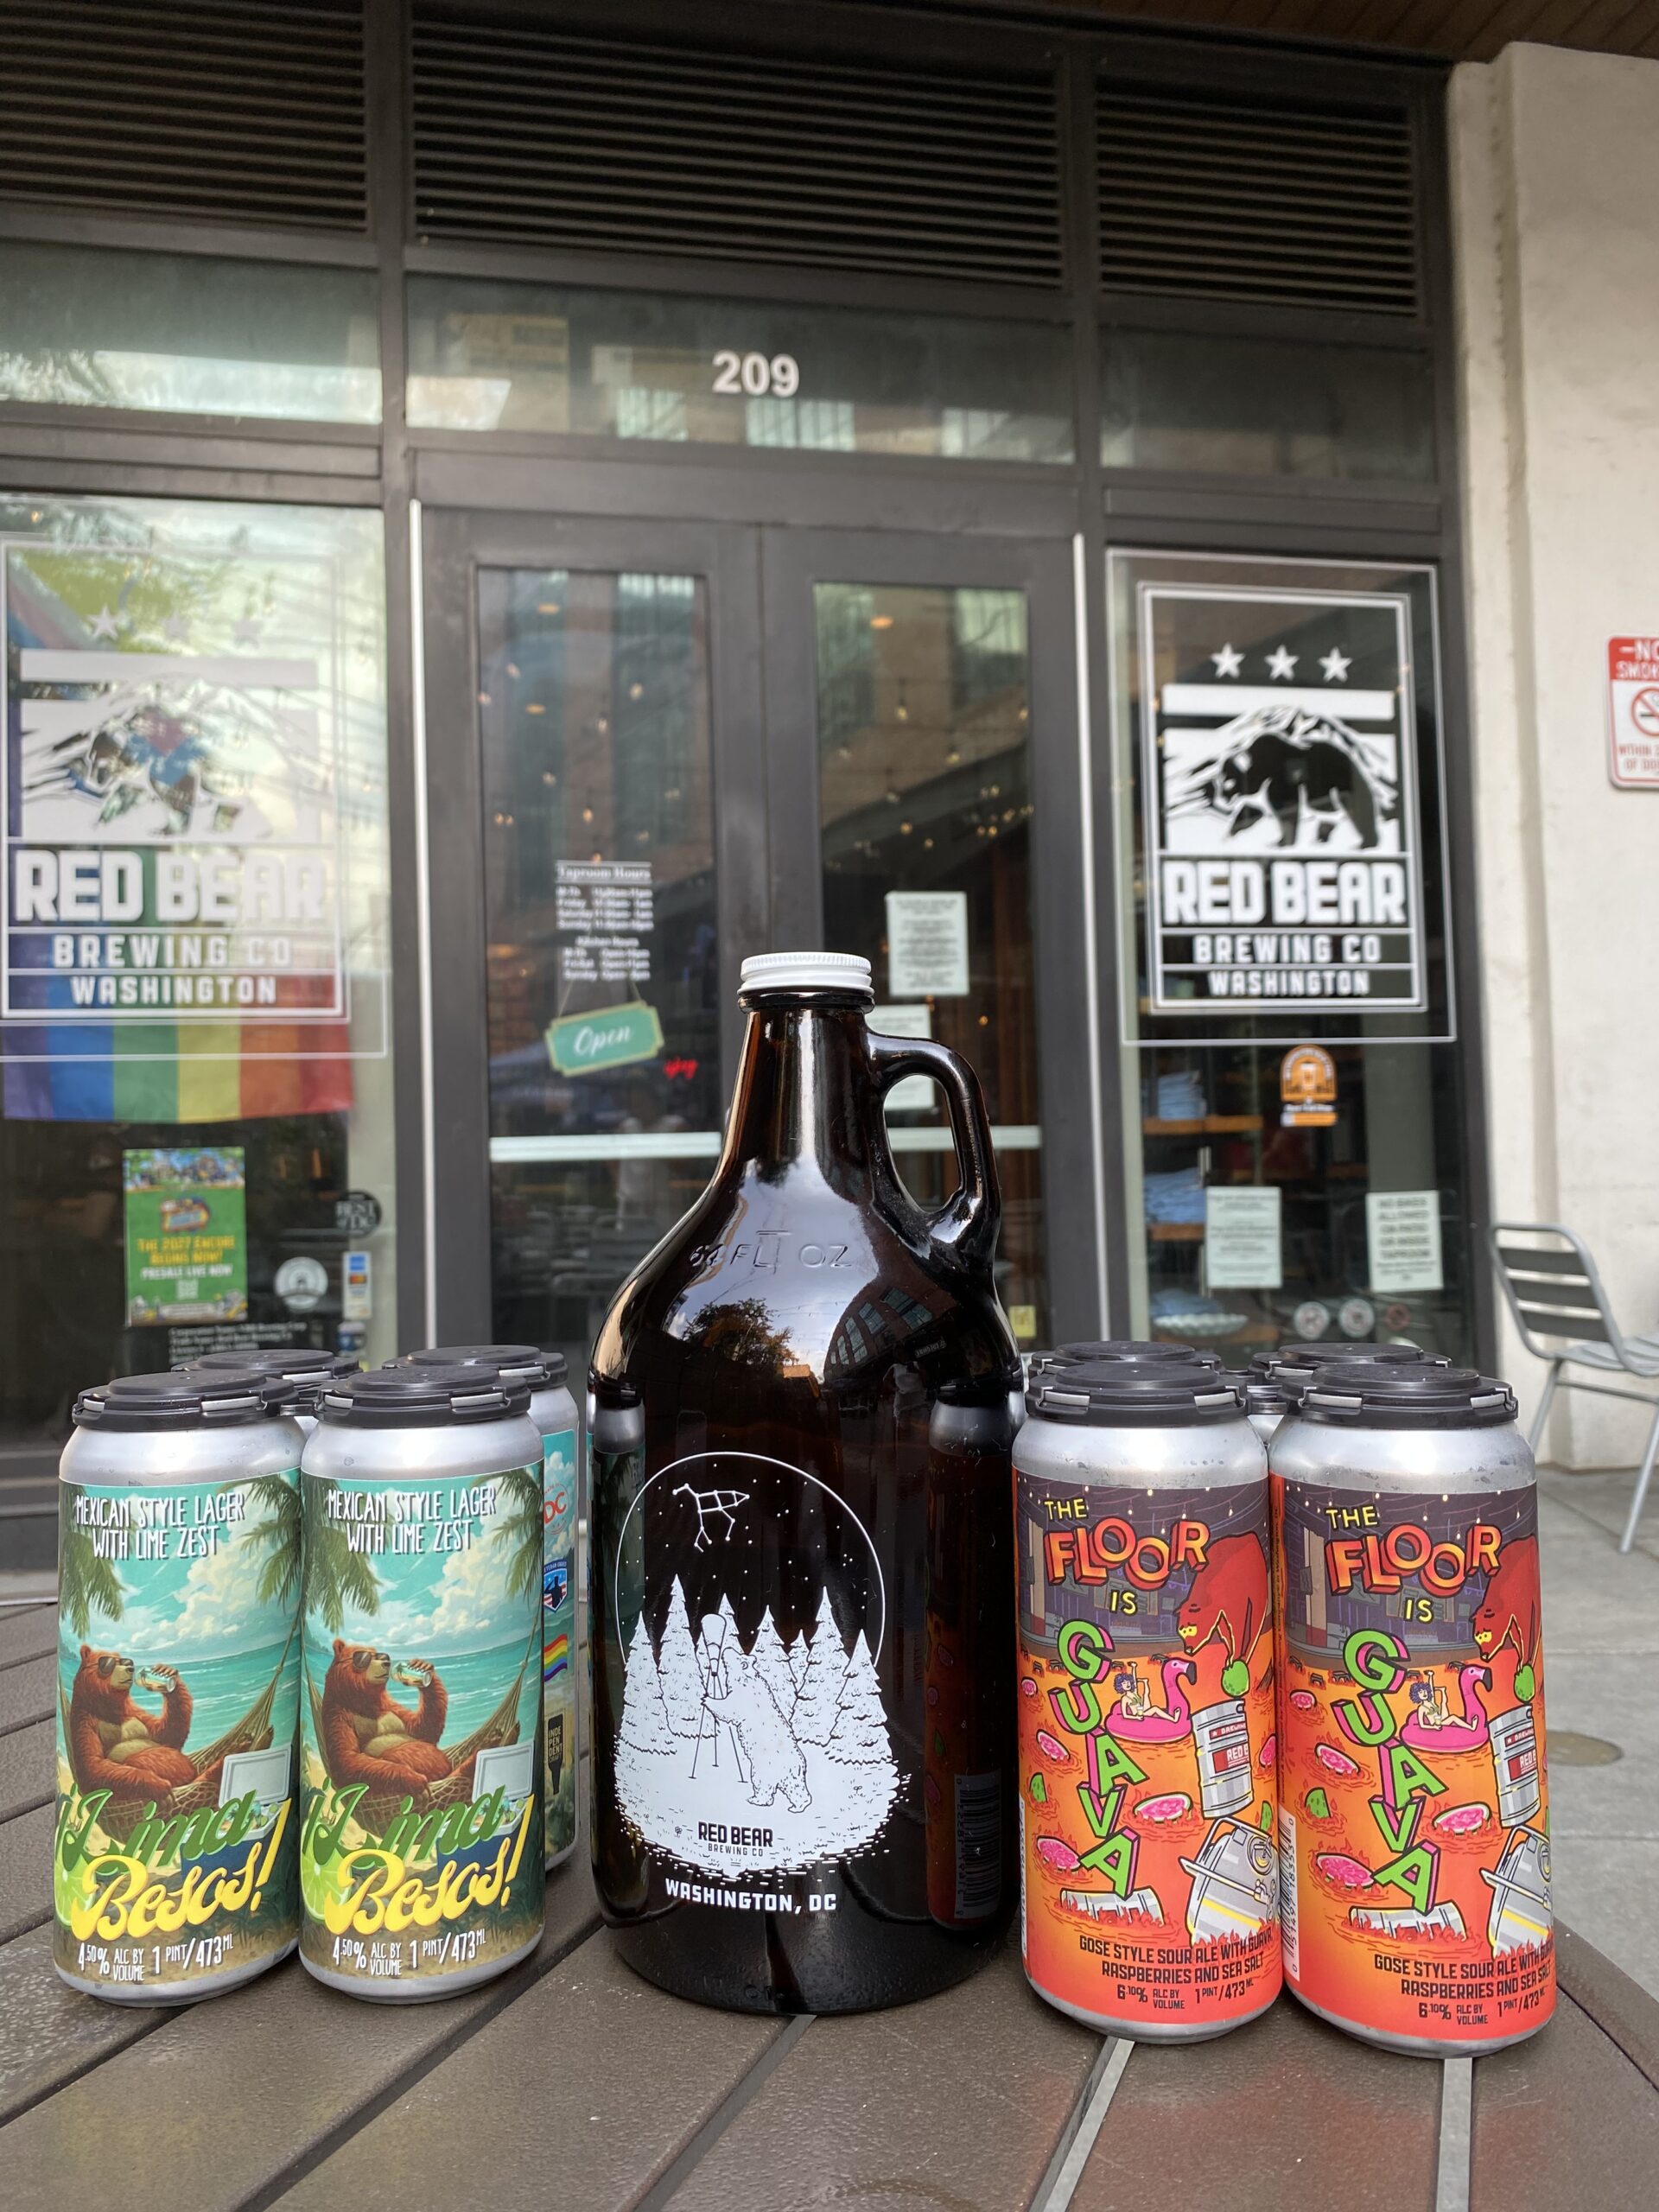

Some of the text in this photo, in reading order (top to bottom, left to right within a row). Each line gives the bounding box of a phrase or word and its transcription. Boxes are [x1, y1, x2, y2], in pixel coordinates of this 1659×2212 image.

[712, 349, 800, 397] 209
[16, 849, 324, 923] RED BEAR
[558, 866, 651, 881] Taproom Hours
[1163, 861, 1406, 925] RED BEAR
[54, 934, 292, 968] BREWING CO
[1193, 934, 1381, 964] BREWING CO
[70, 975, 277, 1005] WASHINGTON
[1210, 970, 1370, 995] WASHINGTON
[574, 1025, 632, 1056] Open
[799, 1243, 852, 1268] OZ
[76, 1491, 245, 1529] MEXICAN STYLE LAGER
[327, 1485, 497, 1522] MEXICAN STYLE LAGER
[543, 1491, 566, 1524] DC
[1044, 1497, 1088, 1520] THE
[1325, 1505, 1379, 1529] THE
[92, 1525, 219, 1560] WITH LIME ZEST
[346, 1520, 474, 1555] WITH LIME ZEST
[1043, 1516, 1210, 1591] FLOOR
[1325, 1523, 1503, 1598] FLOOR
[1109, 1591, 1137, 1615] IS
[1404, 1598, 1434, 1624] IS
[1226, 1745, 1243, 1762] RED
[698, 1821, 773, 1848] RED BEAR
[708, 1843, 764, 1857] BREWING CO
[665, 1877, 836, 1915] WASHINGTON, DC
[114, 1948, 144, 1964] ALC BY
[152, 1945, 161, 1974] 1
[371, 1942, 402, 1959] ALC BY
[409, 1942, 418, 1969] 1
[1079, 1935, 1110, 1957] GOSE
[1113, 1945, 1154, 1964] STYLE
[1157, 1948, 1192, 1964] SOUR
[1195, 1946, 1217, 1963] ALE
[1221, 1936, 1247, 1961] WITH
[112, 1964, 145, 1981] VOLUME
[370, 1959, 403, 1976] VOLUME
[1102, 1951, 1264, 1984] RASPBERRIES AND SEA SALT
[1374, 1953, 1410, 1974] GOSE
[1414, 1961, 1458, 1979] STYLE
[1460, 1962, 1494, 1979] SOUR
[1497, 1957, 1516, 1976] ALE
[1519, 1948, 1539, 1971] WITH
[1153, 1989, 1180, 1999] ALC BY
[1195, 1988, 1201, 2004] 1
[1401, 1979, 1494, 1999] RASPBERRIES
[1497, 1977, 1518, 1997] AND
[1521, 1970, 1537, 1992] SEA
[1153, 1999, 1185, 2010] VOLUME
[1456, 2004, 1483, 2014] ALC BY
[1497, 2001, 1503, 2018] 1
[1456, 2015, 1488, 2025] VOLUME
